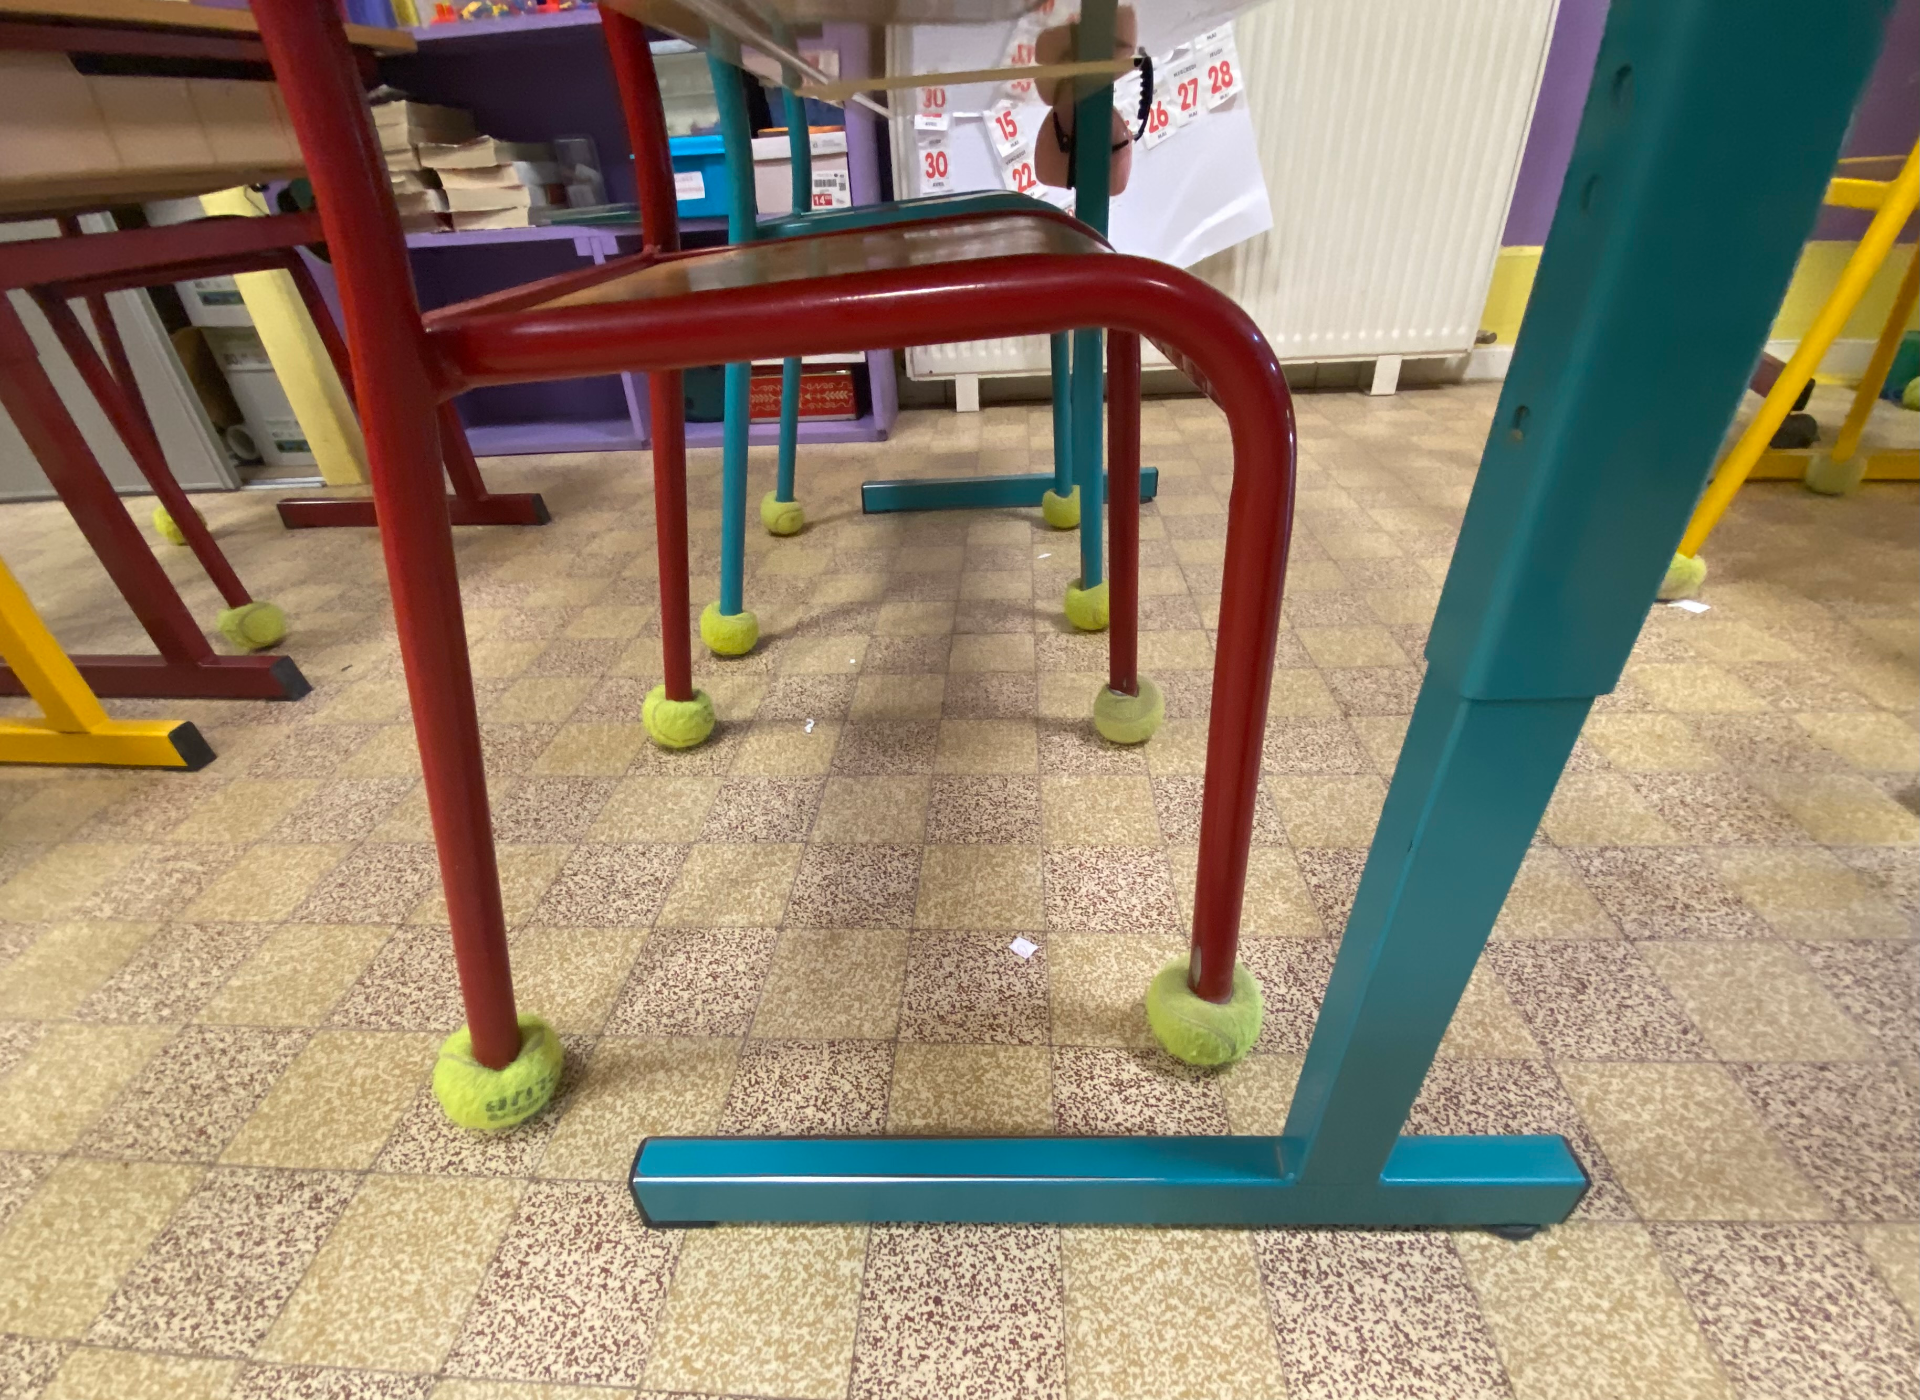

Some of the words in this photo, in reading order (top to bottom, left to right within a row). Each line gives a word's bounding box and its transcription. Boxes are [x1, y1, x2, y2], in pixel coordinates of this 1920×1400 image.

[1207, 60, 1234, 95] 28
[1177, 77, 1199, 112] 27
[995, 110, 1018, 141] 15
[1147, 100, 1169, 134] 26
[925, 150, 948, 179] 30
[1012, 162, 1037, 193] 22
